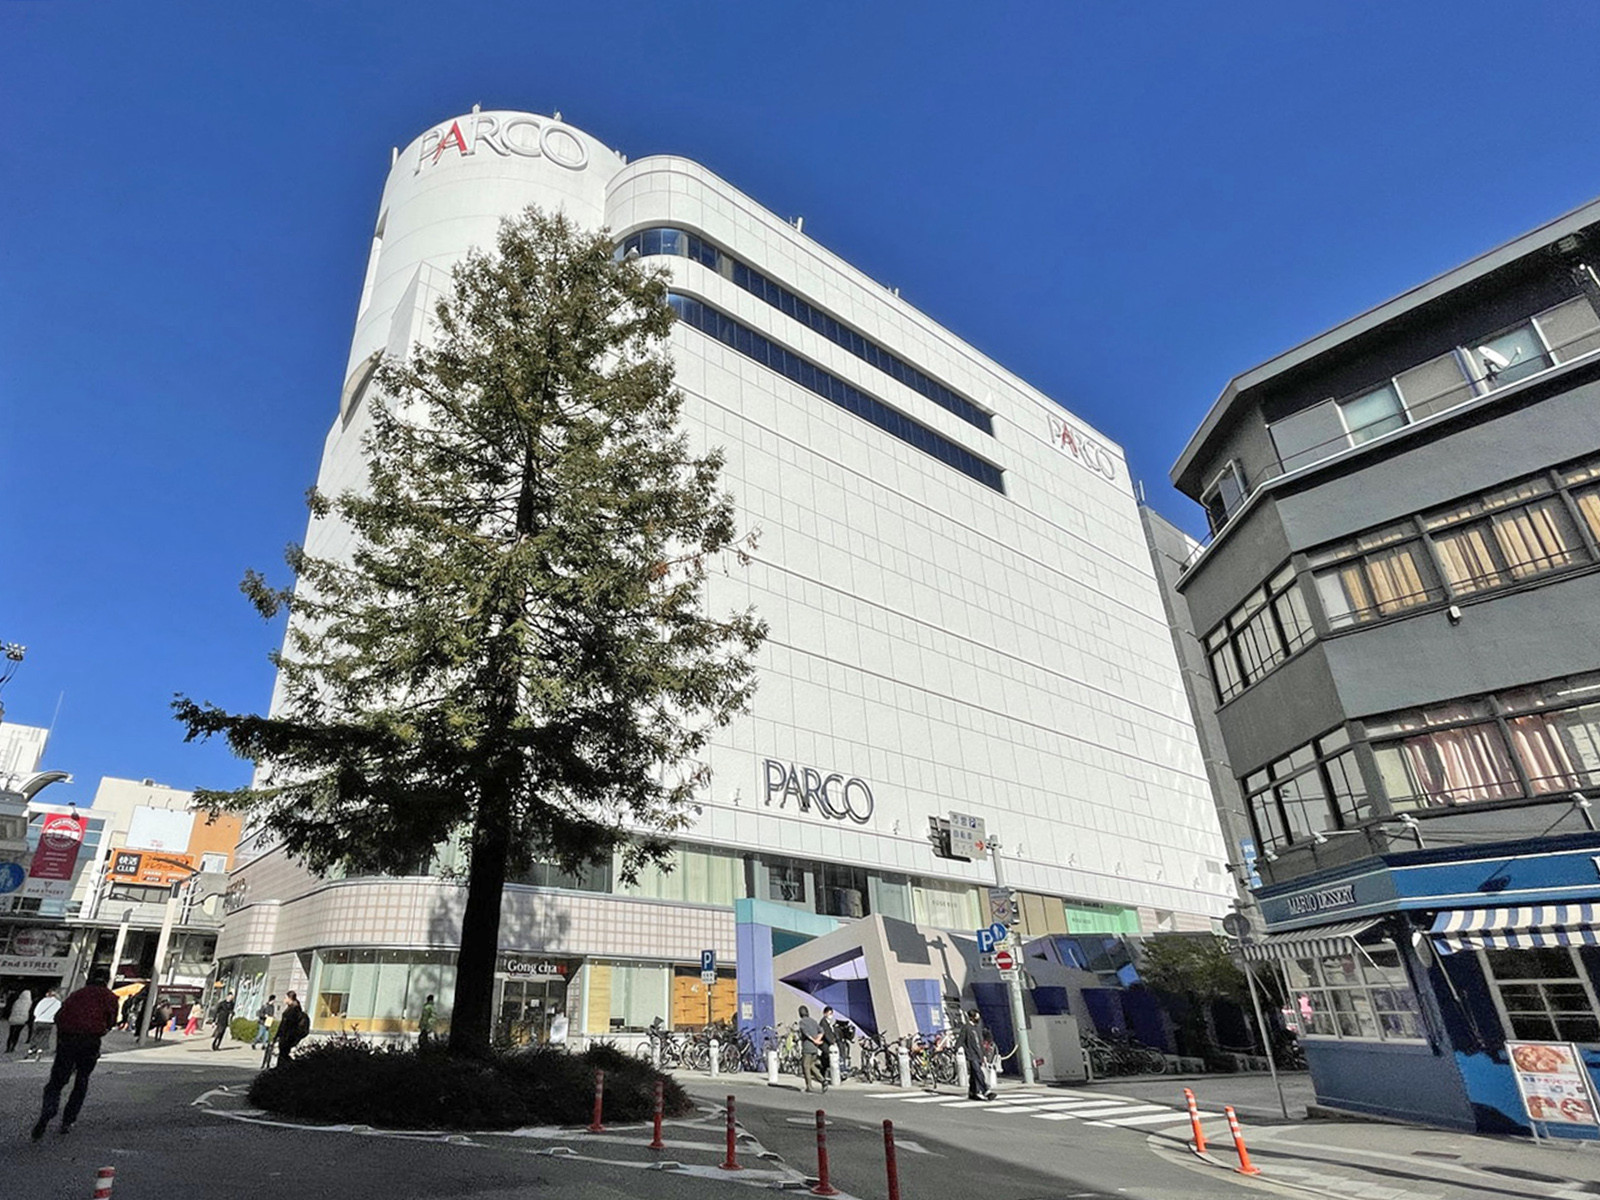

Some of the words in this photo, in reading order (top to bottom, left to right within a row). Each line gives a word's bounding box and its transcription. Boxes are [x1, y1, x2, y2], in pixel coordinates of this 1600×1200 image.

[414, 114, 590, 177] PARCO
[1046, 413, 1115, 481] PARCO
[762, 758, 874, 825] PARCO
[1287, 892, 1317, 915] MARIO
[980, 931, 994, 952] P
[22, 961, 58, 969] STREET
[507, 959, 537, 977] Gong
[537, 960, 558, 973] cha
[704, 951, 712, 970] P
